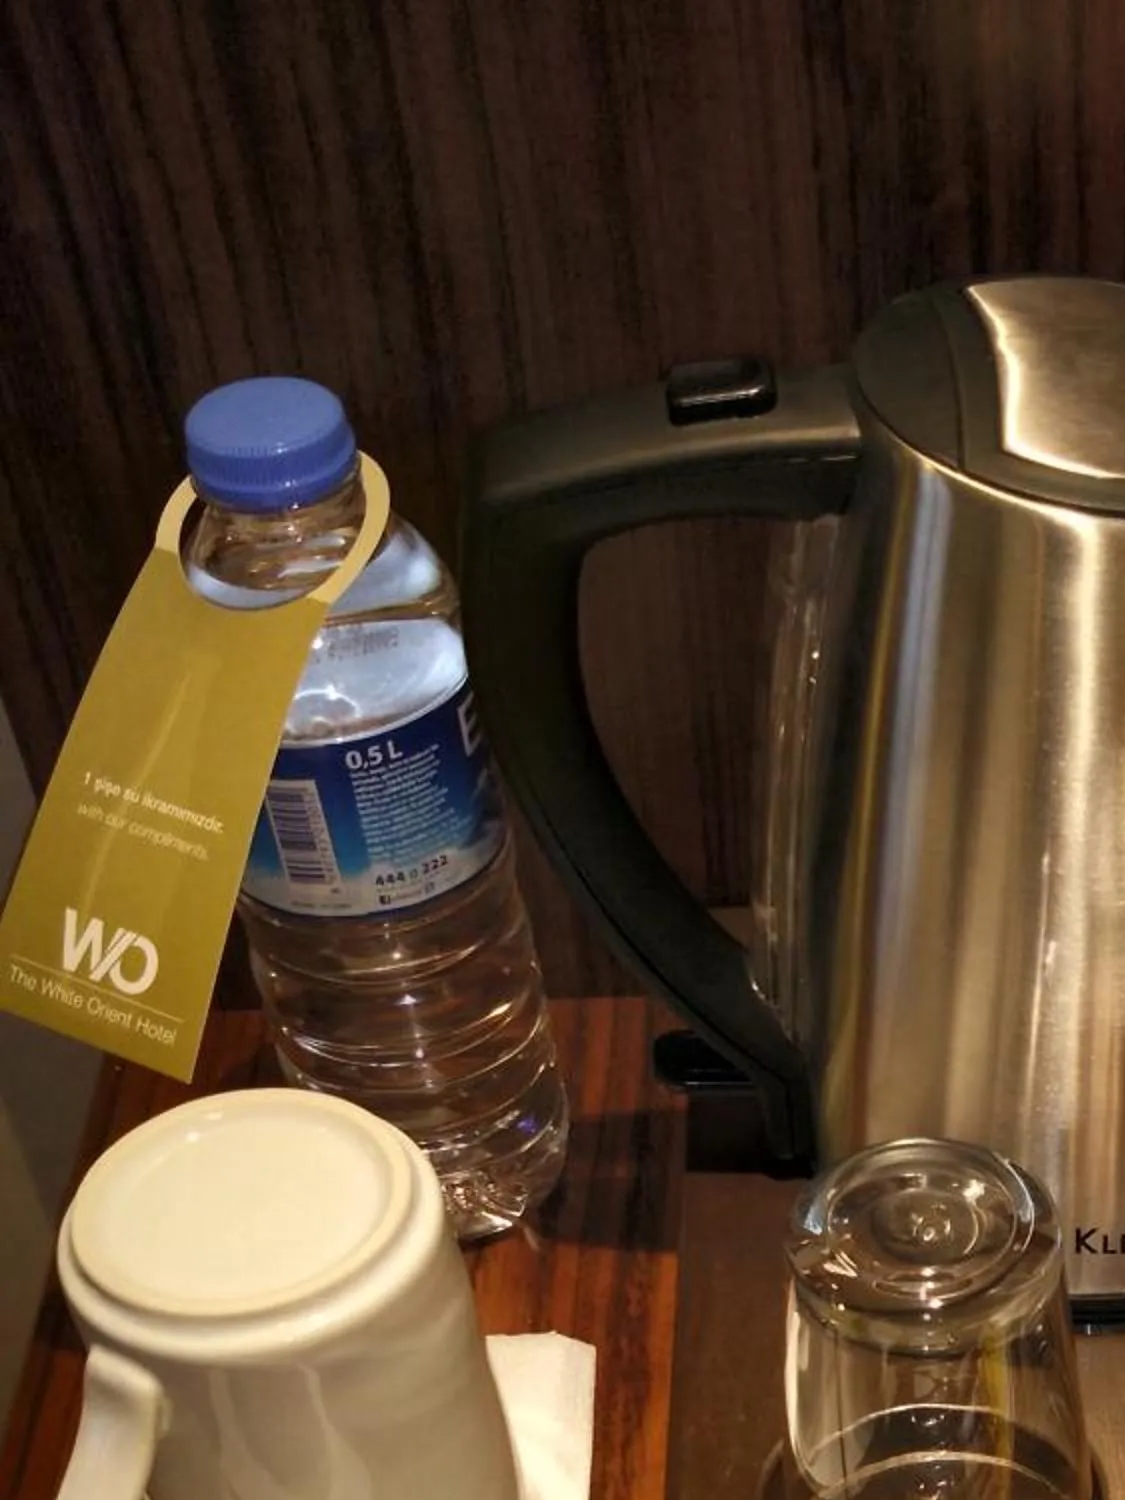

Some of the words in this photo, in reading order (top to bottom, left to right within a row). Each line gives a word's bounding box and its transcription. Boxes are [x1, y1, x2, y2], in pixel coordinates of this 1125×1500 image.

[345, 744, 383, 770] 0,5
[387, 739, 404, 760] L
[62, 905, 159, 995] WO
[9, 964, 37, 991] The
[40, 977, 84, 1008] White
[86, 997, 133, 1029] Orient
[135, 1014, 177, 1046] Hotel
